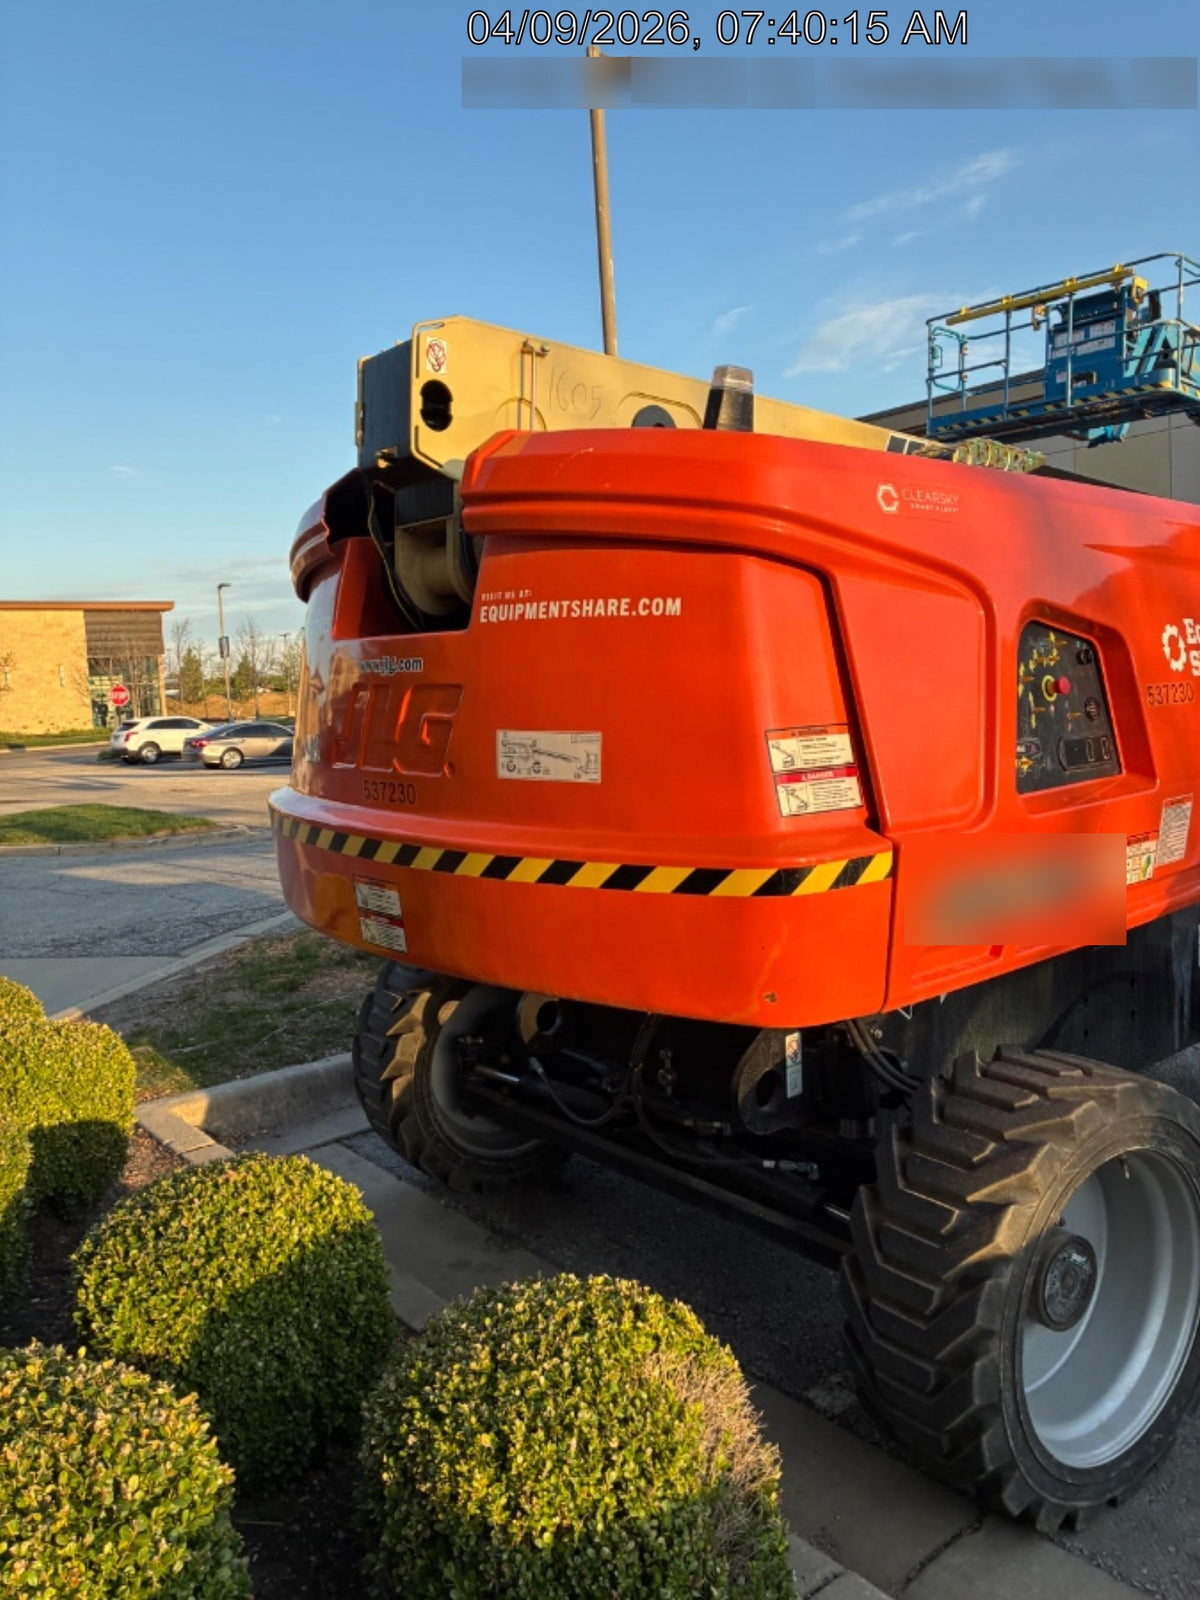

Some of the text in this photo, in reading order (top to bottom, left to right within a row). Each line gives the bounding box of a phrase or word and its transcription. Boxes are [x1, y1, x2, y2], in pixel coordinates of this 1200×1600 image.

[479, 597, 682, 623] EQUIPMENTSHARE.COM
[358, 656, 424, 675] www.jlg.com
[1146, 681, 1195, 706] 537230
[362, 779, 417, 805] 537230
